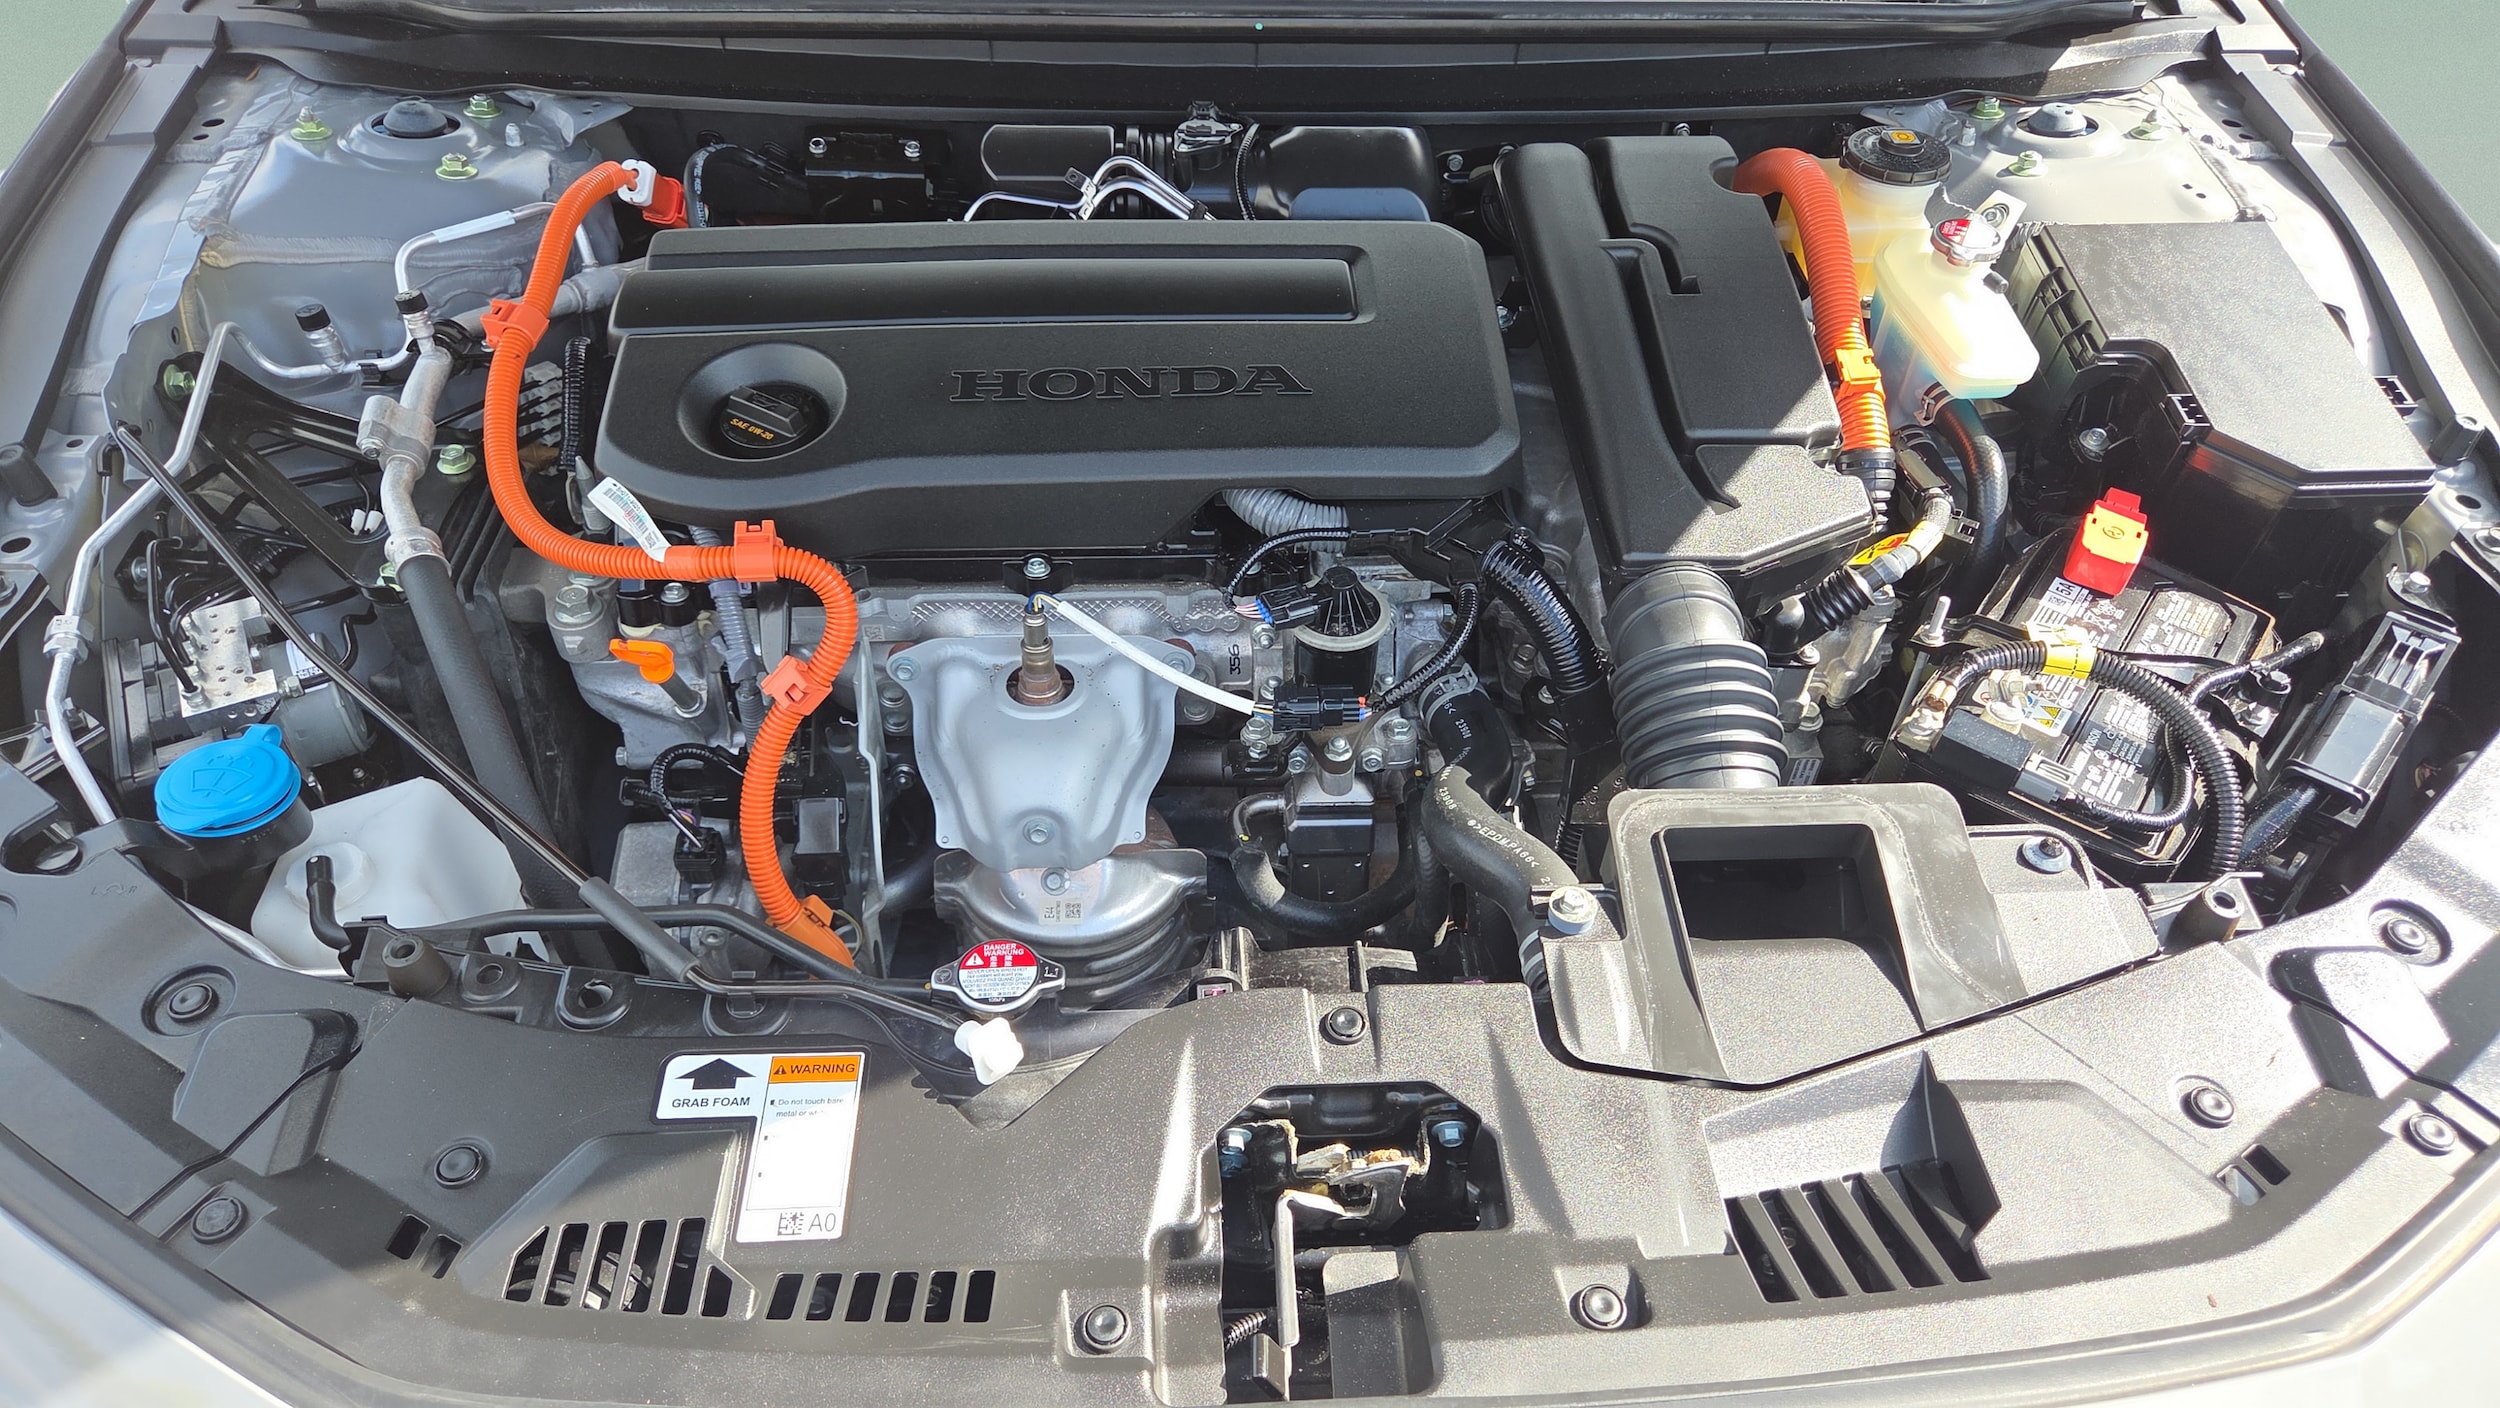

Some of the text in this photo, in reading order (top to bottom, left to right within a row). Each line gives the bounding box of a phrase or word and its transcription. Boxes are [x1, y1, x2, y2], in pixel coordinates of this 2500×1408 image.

[949, 364, 1314, 402] HONDA
[729, 418, 749, 431] SAE
[747, 423, 775, 441] 0W-20
[2055, 581, 2077, 597] 5A
[1228, 643, 1241, 675] 356
[984, 943, 1017, 951] DANGER
[984, 948, 1024, 957] WARNUNG
[789, 1063, 856, 1075] WARNING
[671, 1096, 751, 1109] GRAB FOAM
[790, 1098, 804, 1106] not
[804, 1097, 826, 1105] touch
[776, 1110, 798, 1118] metal
[808, 1211, 837, 1233] A0
